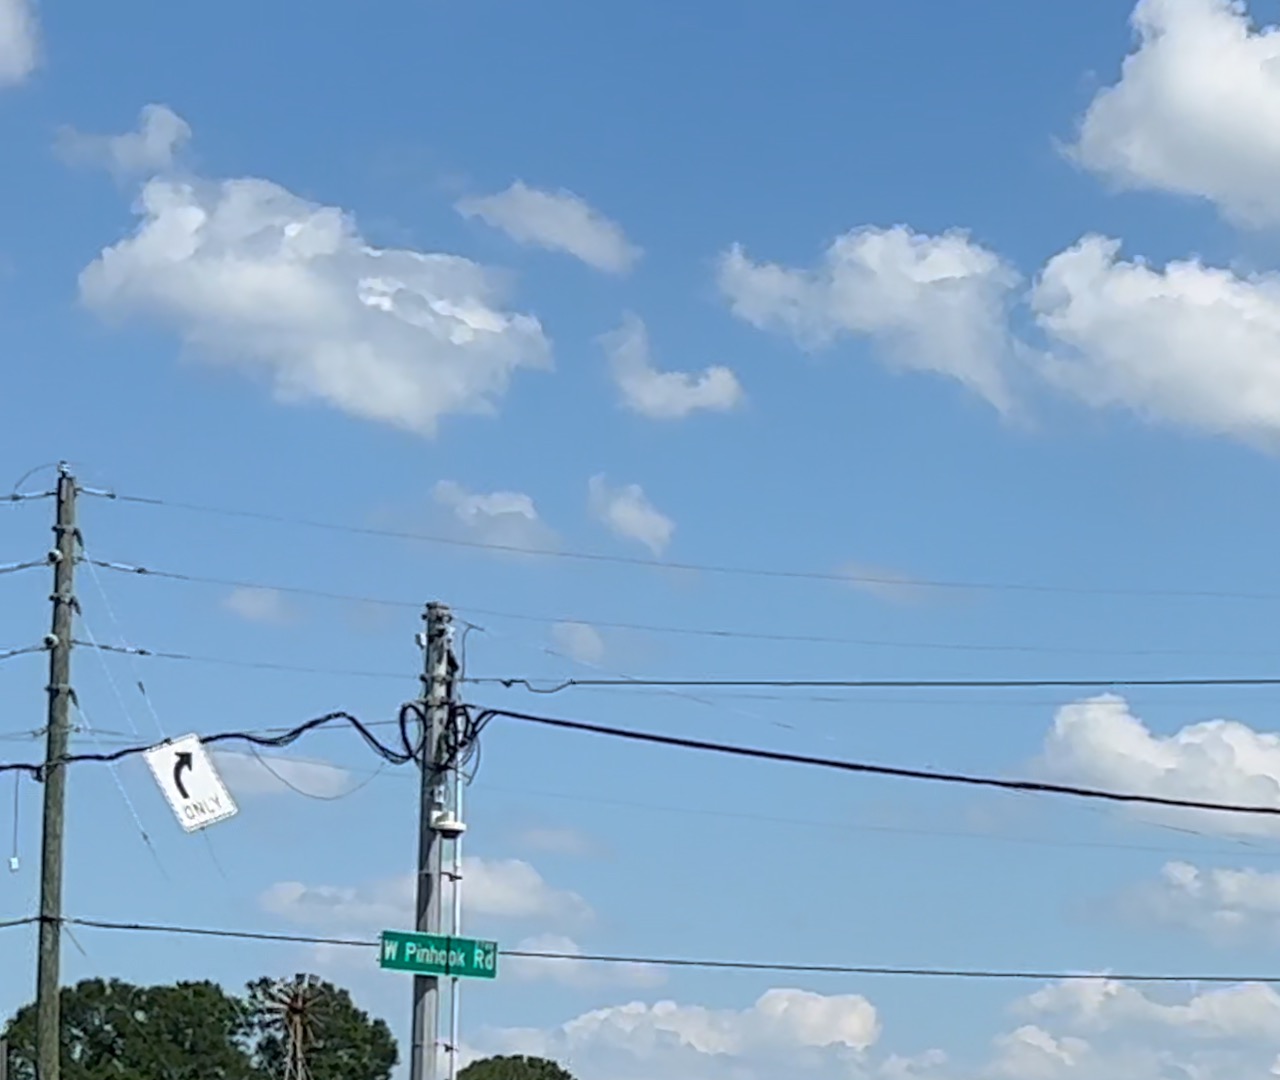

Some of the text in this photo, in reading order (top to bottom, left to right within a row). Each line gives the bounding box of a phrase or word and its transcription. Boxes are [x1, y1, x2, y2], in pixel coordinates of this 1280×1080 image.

[184, 796, 222, 820] ONLY
[384, 940, 494, 970] W Pinhook Rd
